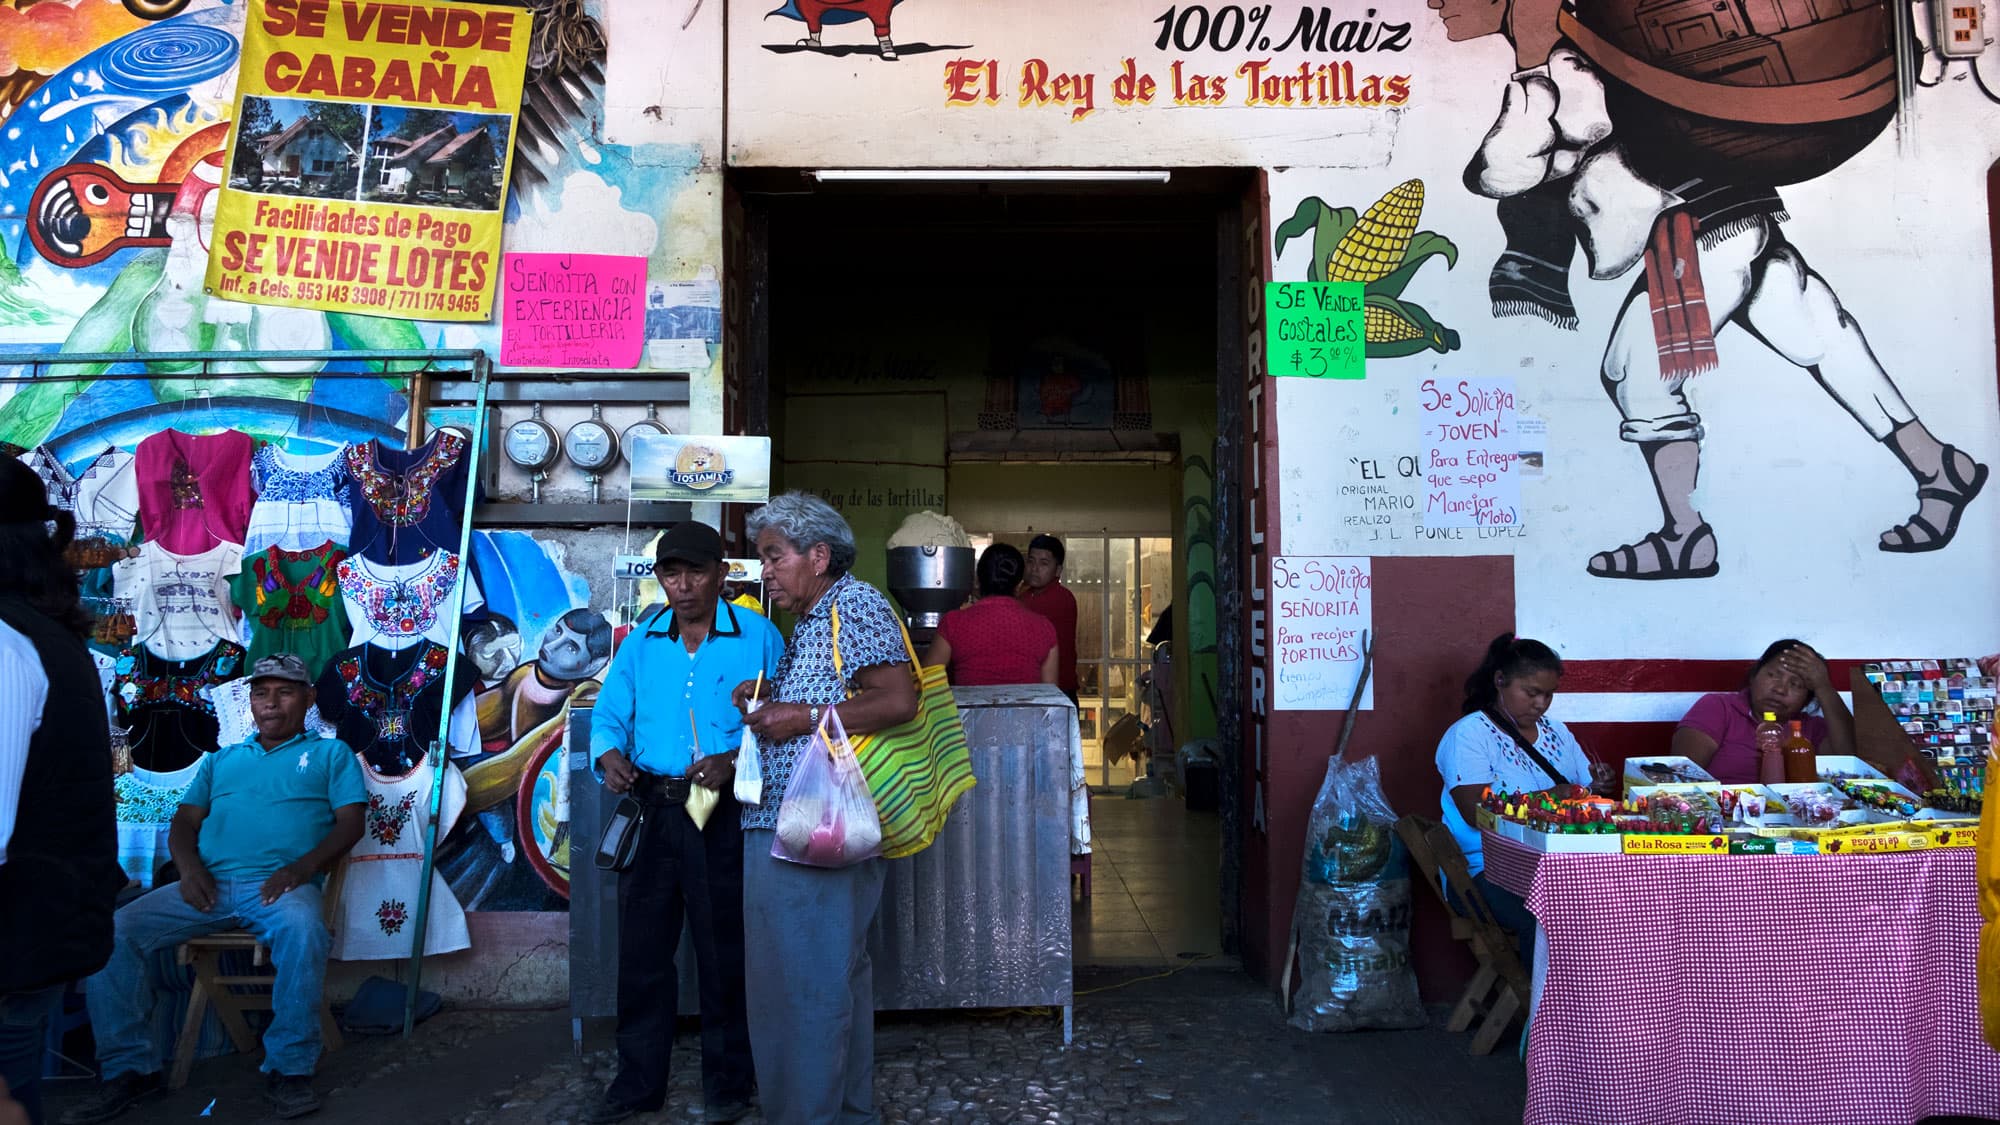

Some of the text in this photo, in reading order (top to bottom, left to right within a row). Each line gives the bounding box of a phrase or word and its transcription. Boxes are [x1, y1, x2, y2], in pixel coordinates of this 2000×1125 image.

[262, 0, 514, 52] SE VENDE
[1153, 4, 1412, 53] 100% Maiz
[264, 51, 497, 109] CABAÑA
[945, 57, 1412, 123] El Rey de las Tortillas
[254, 200, 472, 248] Facilidades de Pago
[221, 230, 489, 292] SE VENDE LOTES
[219, 273, 480, 313] Inf. a Cels. 953 143 3908 / 771 174 9455
[611, 273, 637, 296] CON
[515, 297, 632, 321] EXPERIENCIA
[1312, 285, 1361, 312] VENDE
[529, 322, 625, 342] TORTILLERIA
[1421, 380, 1515, 421] Se Solicita
[1428, 448, 1519, 472] Para Entregar
[677, 472, 723, 483] TOSTAMIX
[1427, 471, 1497, 488] que sepa
[1341, 486, 1388, 496] ORIGINAL
[1364, 494, 1415, 512] MARIO
[1427, 491, 1499, 516] Manejar
[1247, 216, 1266, 834] TORTILLERIA
[1343, 514, 1391, 526] REALIZO
[1476, 506, 1517, 526] (Moto)
[1273, 558, 1371, 600] Se Solicita
[1281, 598, 1360, 618] SEÑORITA
[1277, 626, 1303, 646] Para
[1627, 840, 1641, 849] de
[1643, 840, 1652, 849] la
[1655, 840, 1682, 849] Rosa
[1851, 838, 1877, 851] Rosa
[1888, 836, 1900, 849] de
